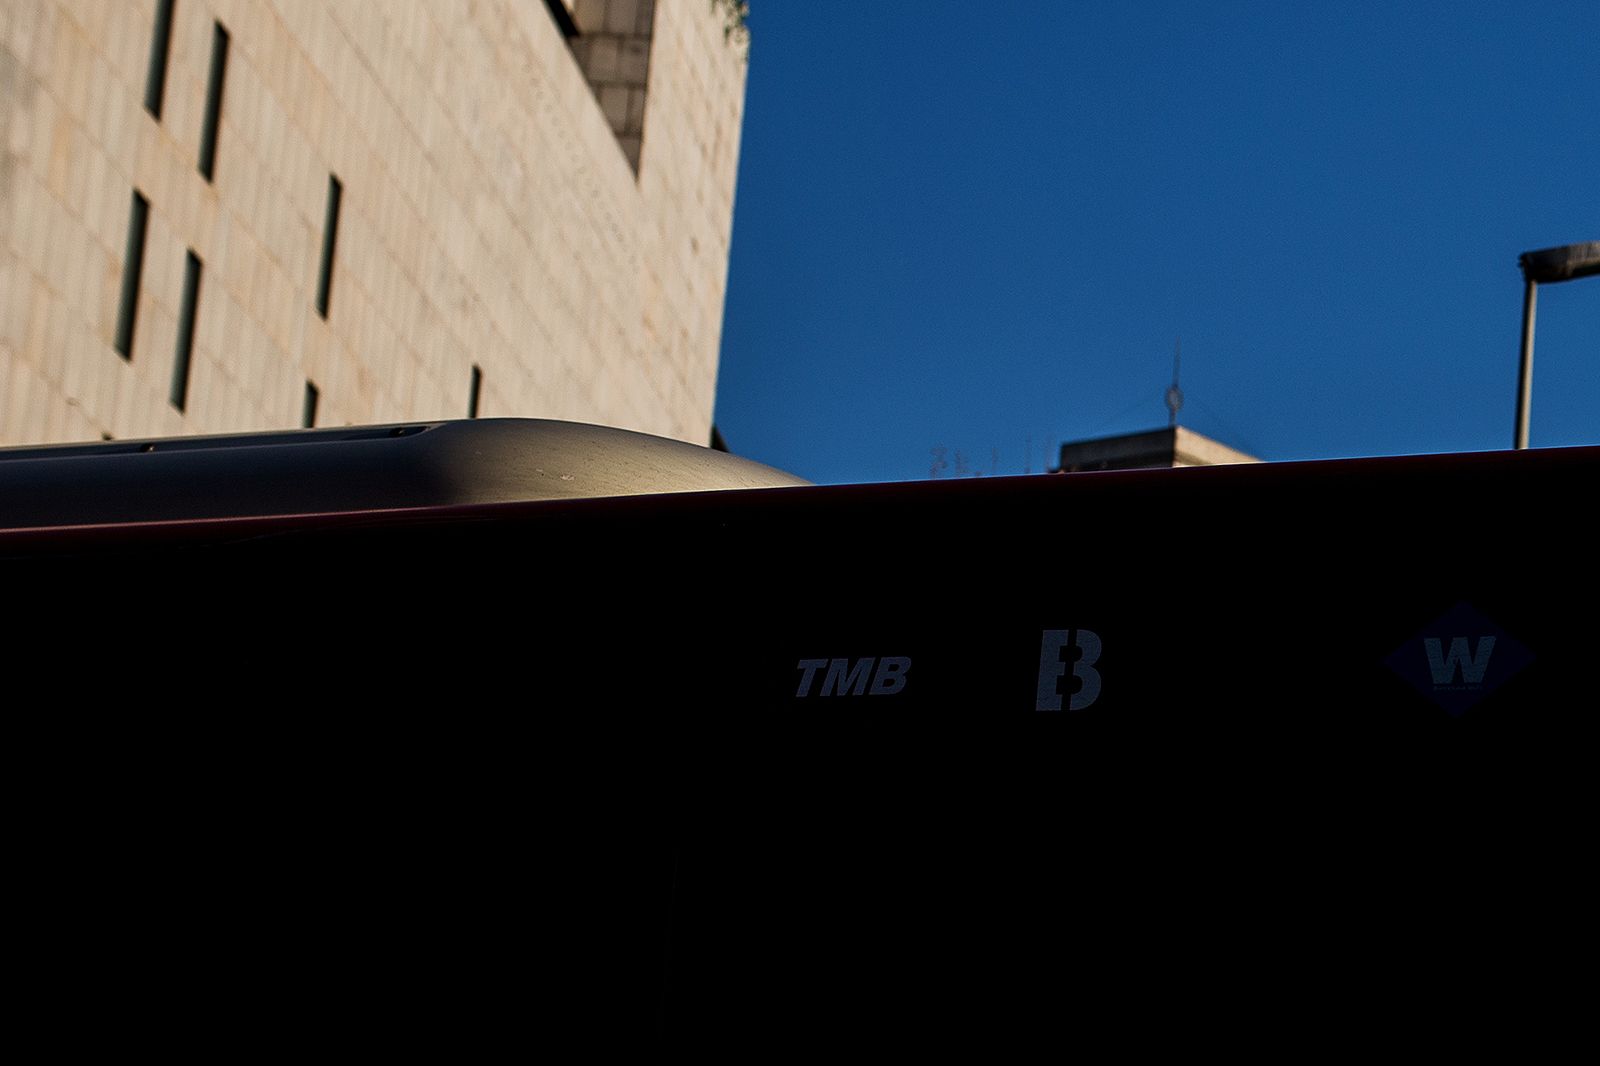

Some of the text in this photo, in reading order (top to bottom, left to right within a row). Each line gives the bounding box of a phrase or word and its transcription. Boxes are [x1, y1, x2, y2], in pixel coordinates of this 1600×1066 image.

[794, 656, 912, 699] TMB
[1034, 629, 1102, 713] B
[1423, 634, 1497, 685] W
